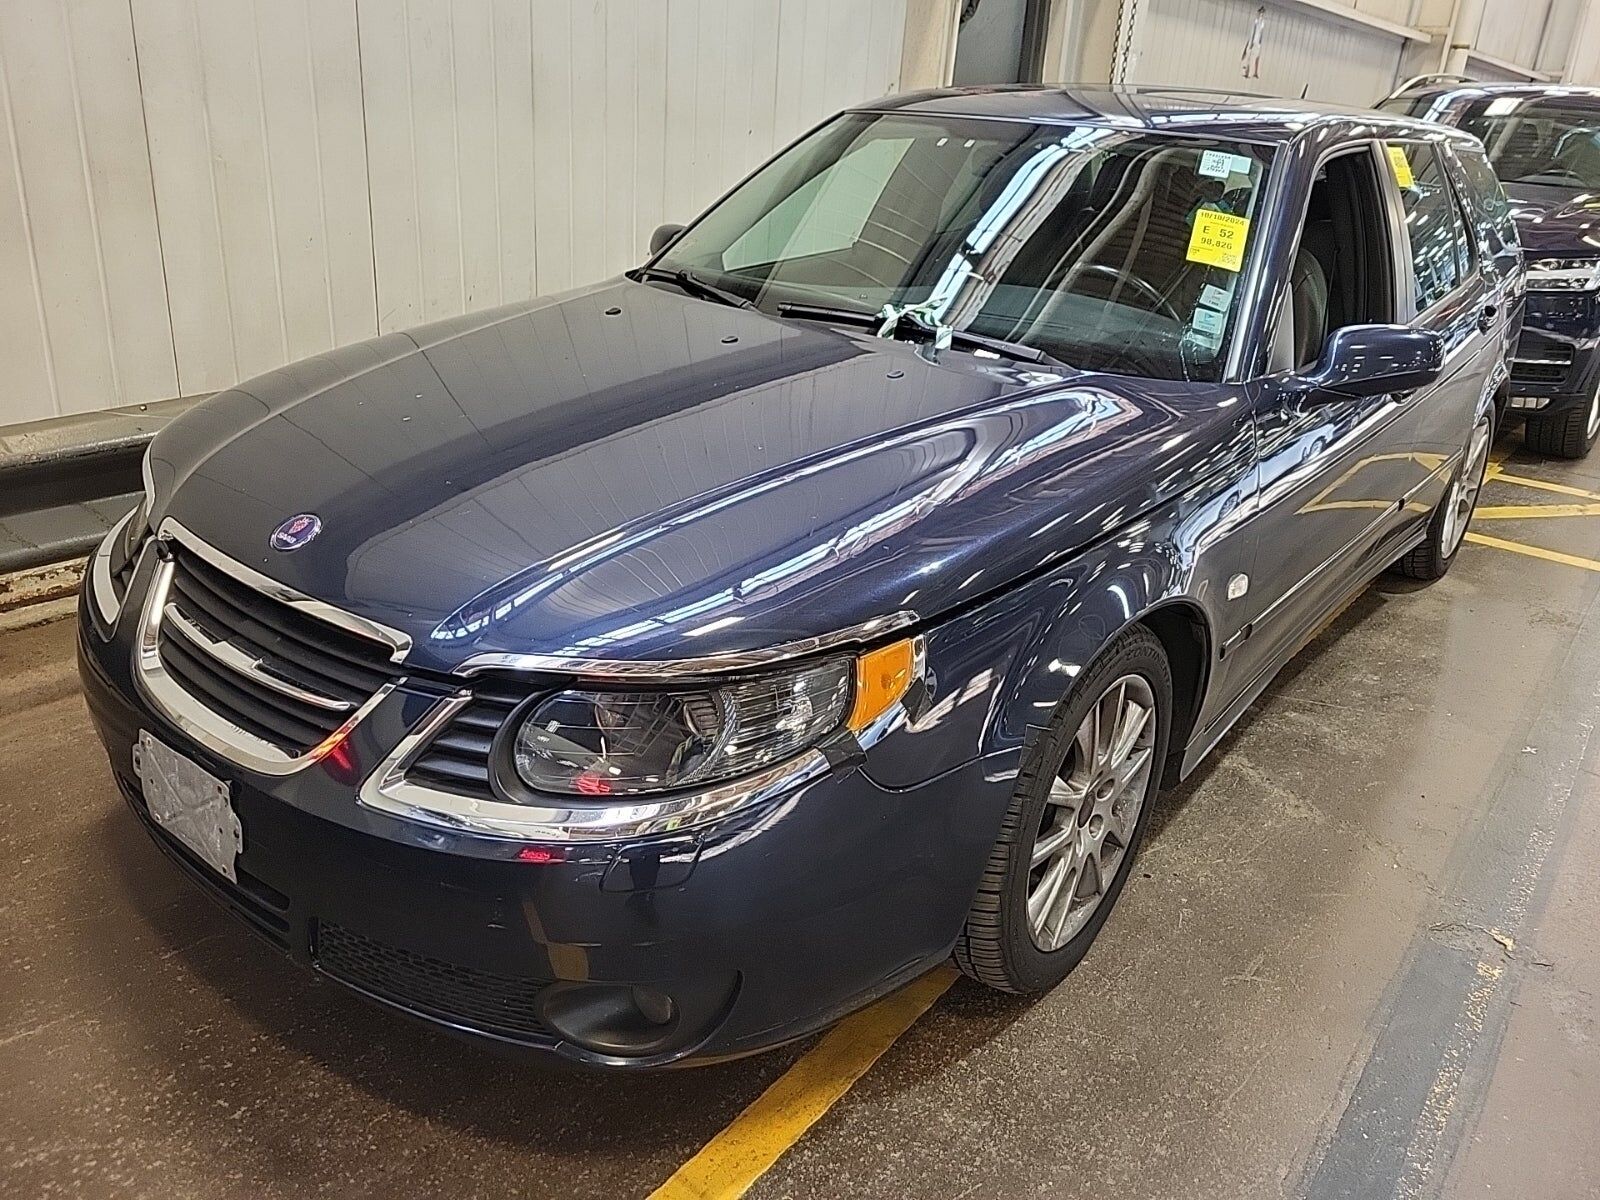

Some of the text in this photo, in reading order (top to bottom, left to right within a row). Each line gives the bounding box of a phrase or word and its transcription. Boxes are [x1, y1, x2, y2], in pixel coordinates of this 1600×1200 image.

[1200, 211, 1245, 226] 10/10/2024
[1202, 225, 1211, 234] E
[1219, 228, 1234, 239] 52
